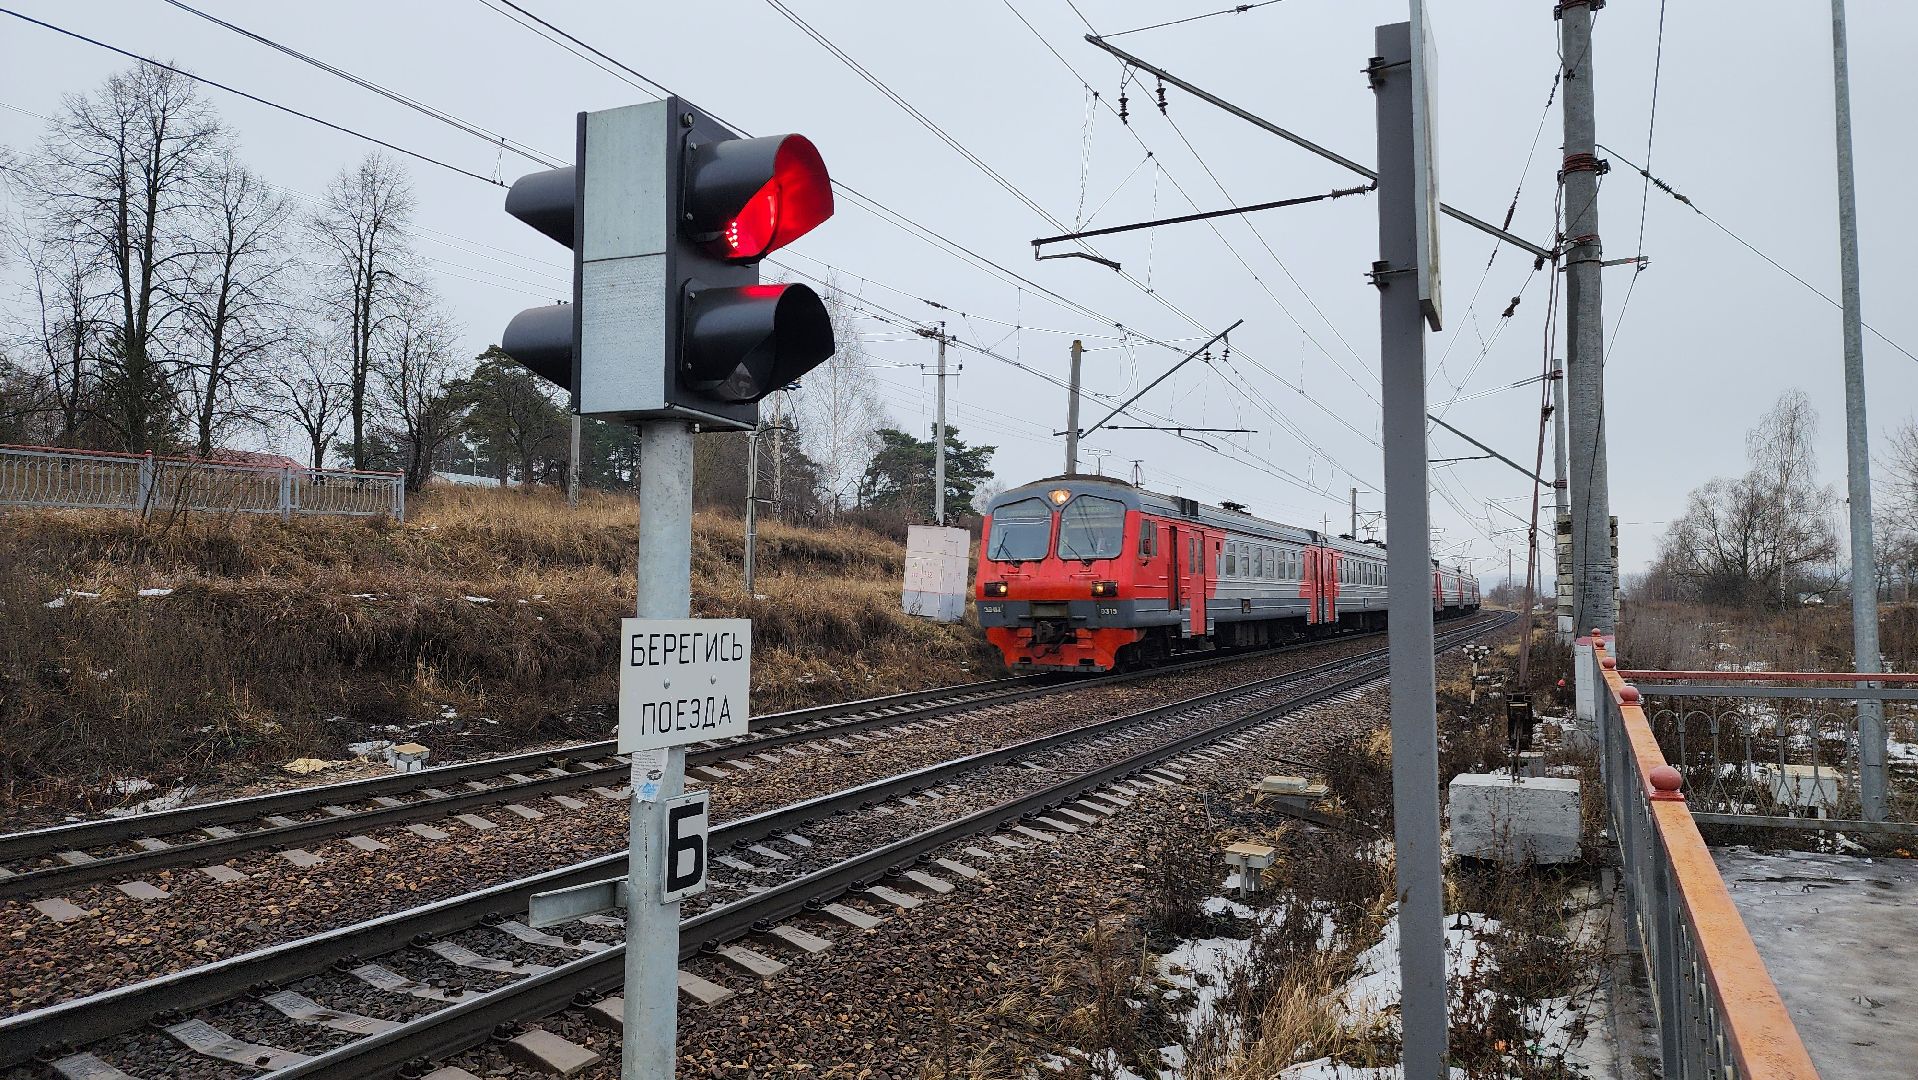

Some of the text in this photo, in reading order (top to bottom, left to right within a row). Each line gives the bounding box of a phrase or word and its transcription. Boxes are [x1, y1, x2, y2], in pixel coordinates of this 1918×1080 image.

[630, 632, 743, 667] БЕРЕГИСЬ
[641, 694, 732, 736] ПОЕЗДА
[666, 801, 705, 894] Б
